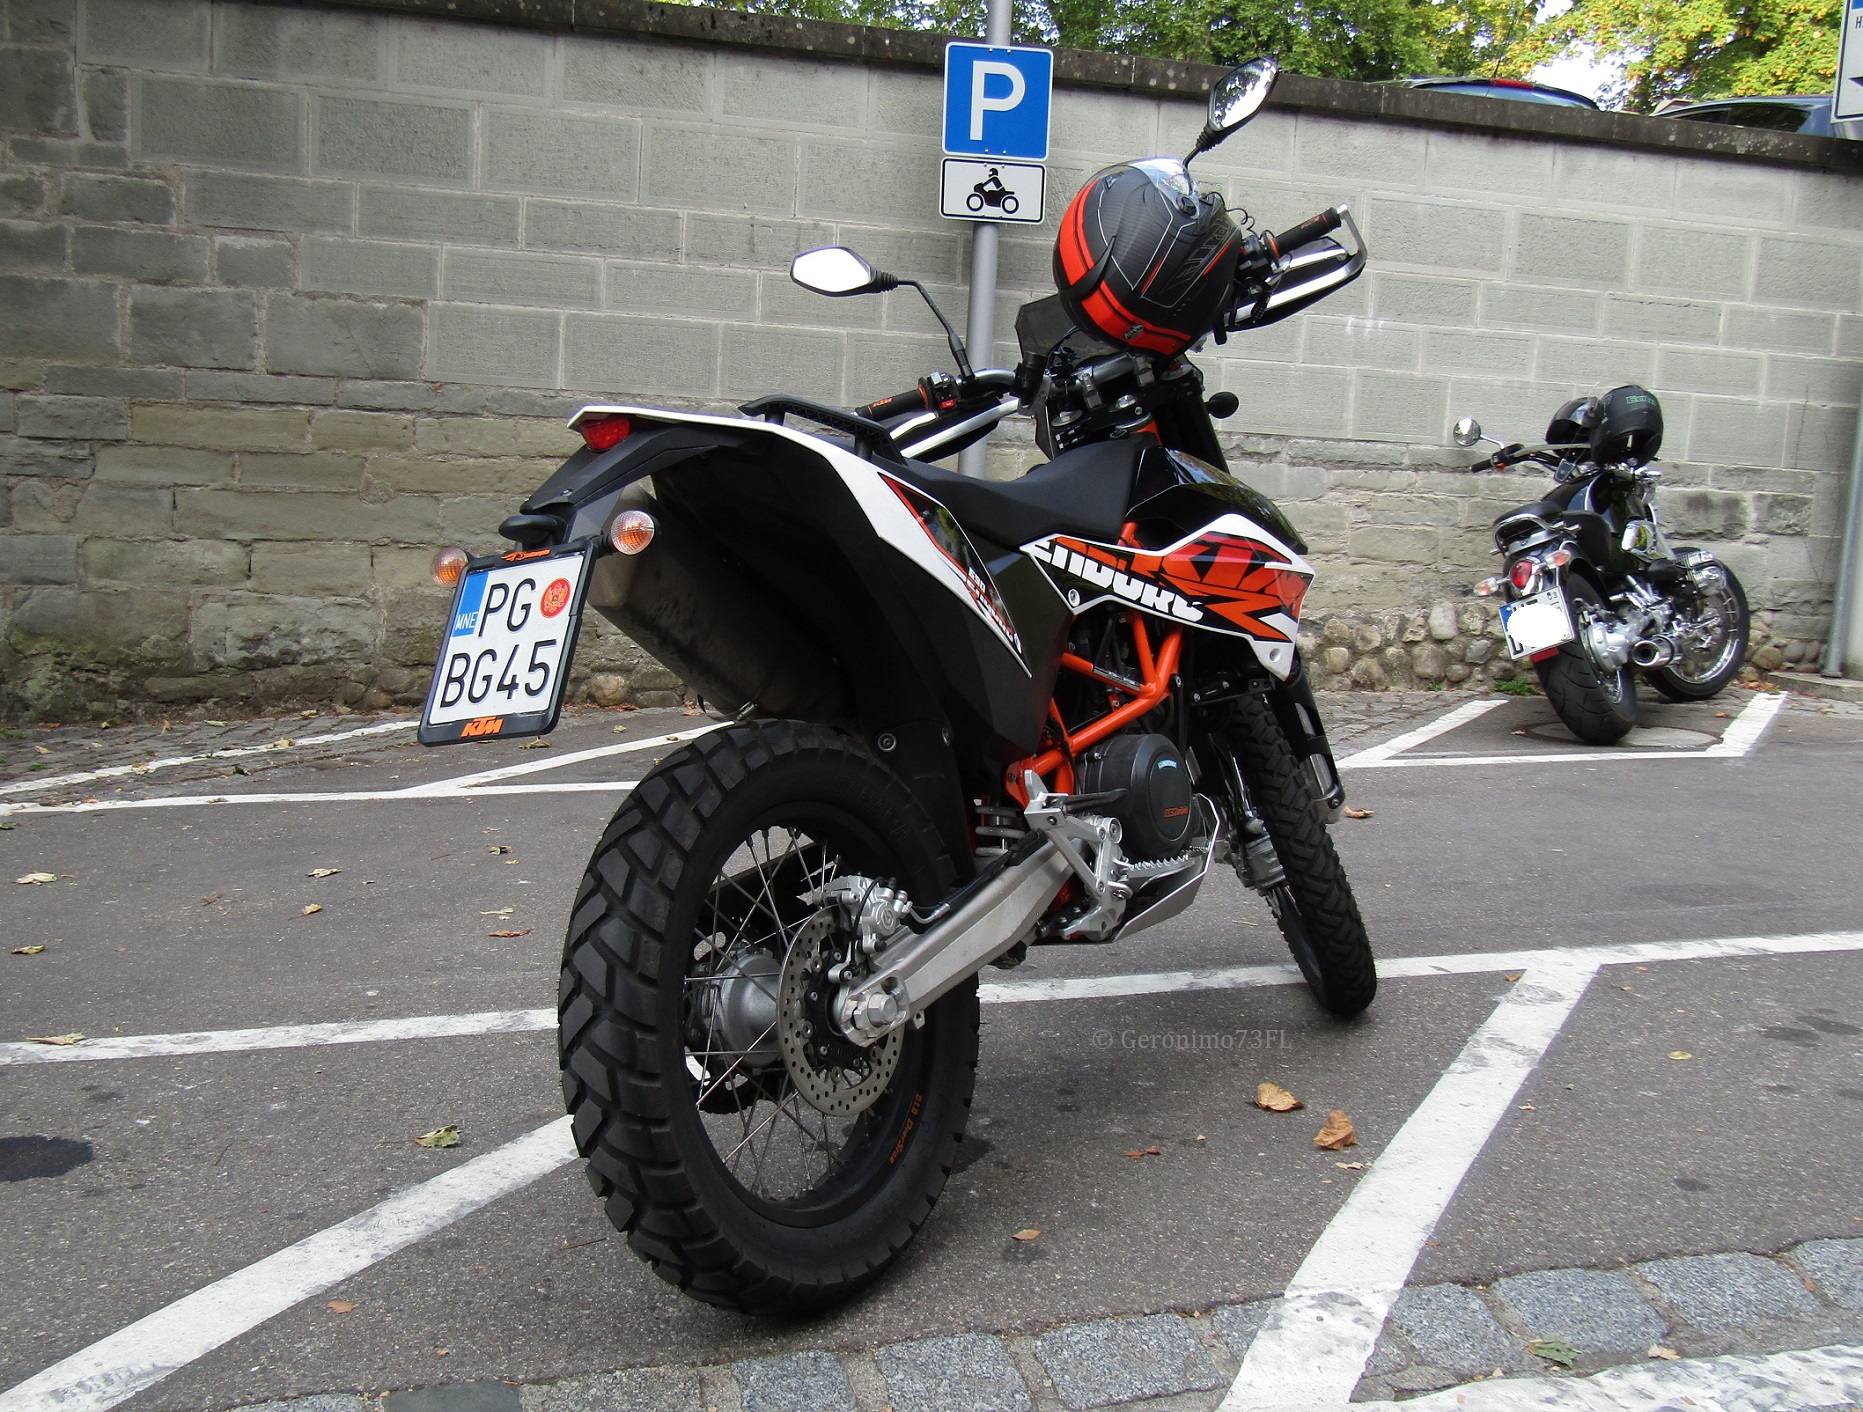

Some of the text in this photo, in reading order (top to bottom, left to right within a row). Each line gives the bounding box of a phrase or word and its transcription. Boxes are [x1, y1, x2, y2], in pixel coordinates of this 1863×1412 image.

[970, 60, 1026, 141] P
[455, 611, 478, 631] MNE
[478, 578, 536, 638] PG
[440, 639, 557, 709] BG45
[461, 716, 504, 738] KTM
